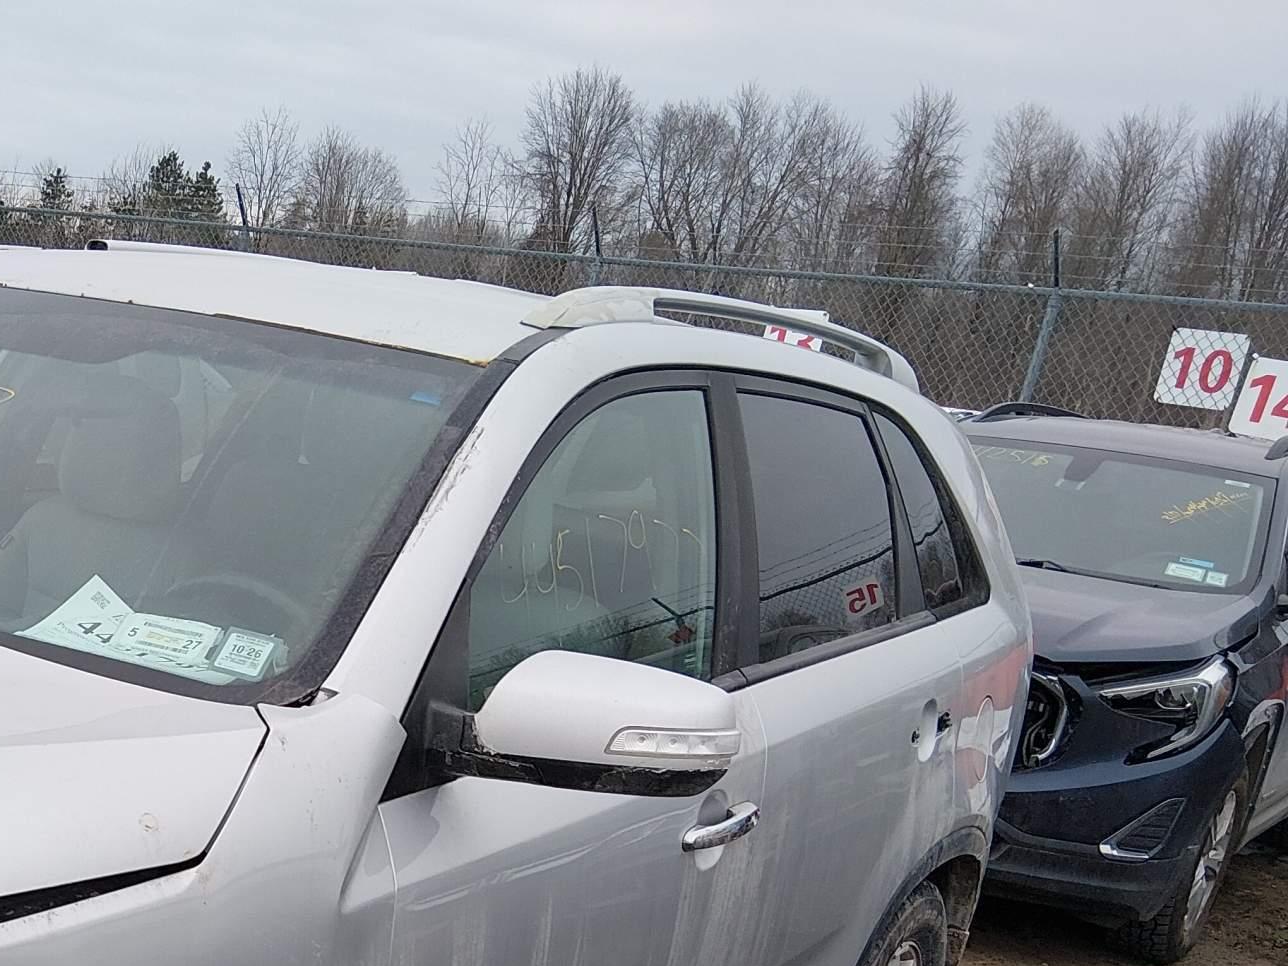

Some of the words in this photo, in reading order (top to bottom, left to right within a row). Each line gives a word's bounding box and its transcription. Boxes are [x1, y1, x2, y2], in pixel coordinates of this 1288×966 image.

[1174, 346, 1234, 394] 10
[127, 627, 140, 637] 5
[182, 639, 202, 650] 27
